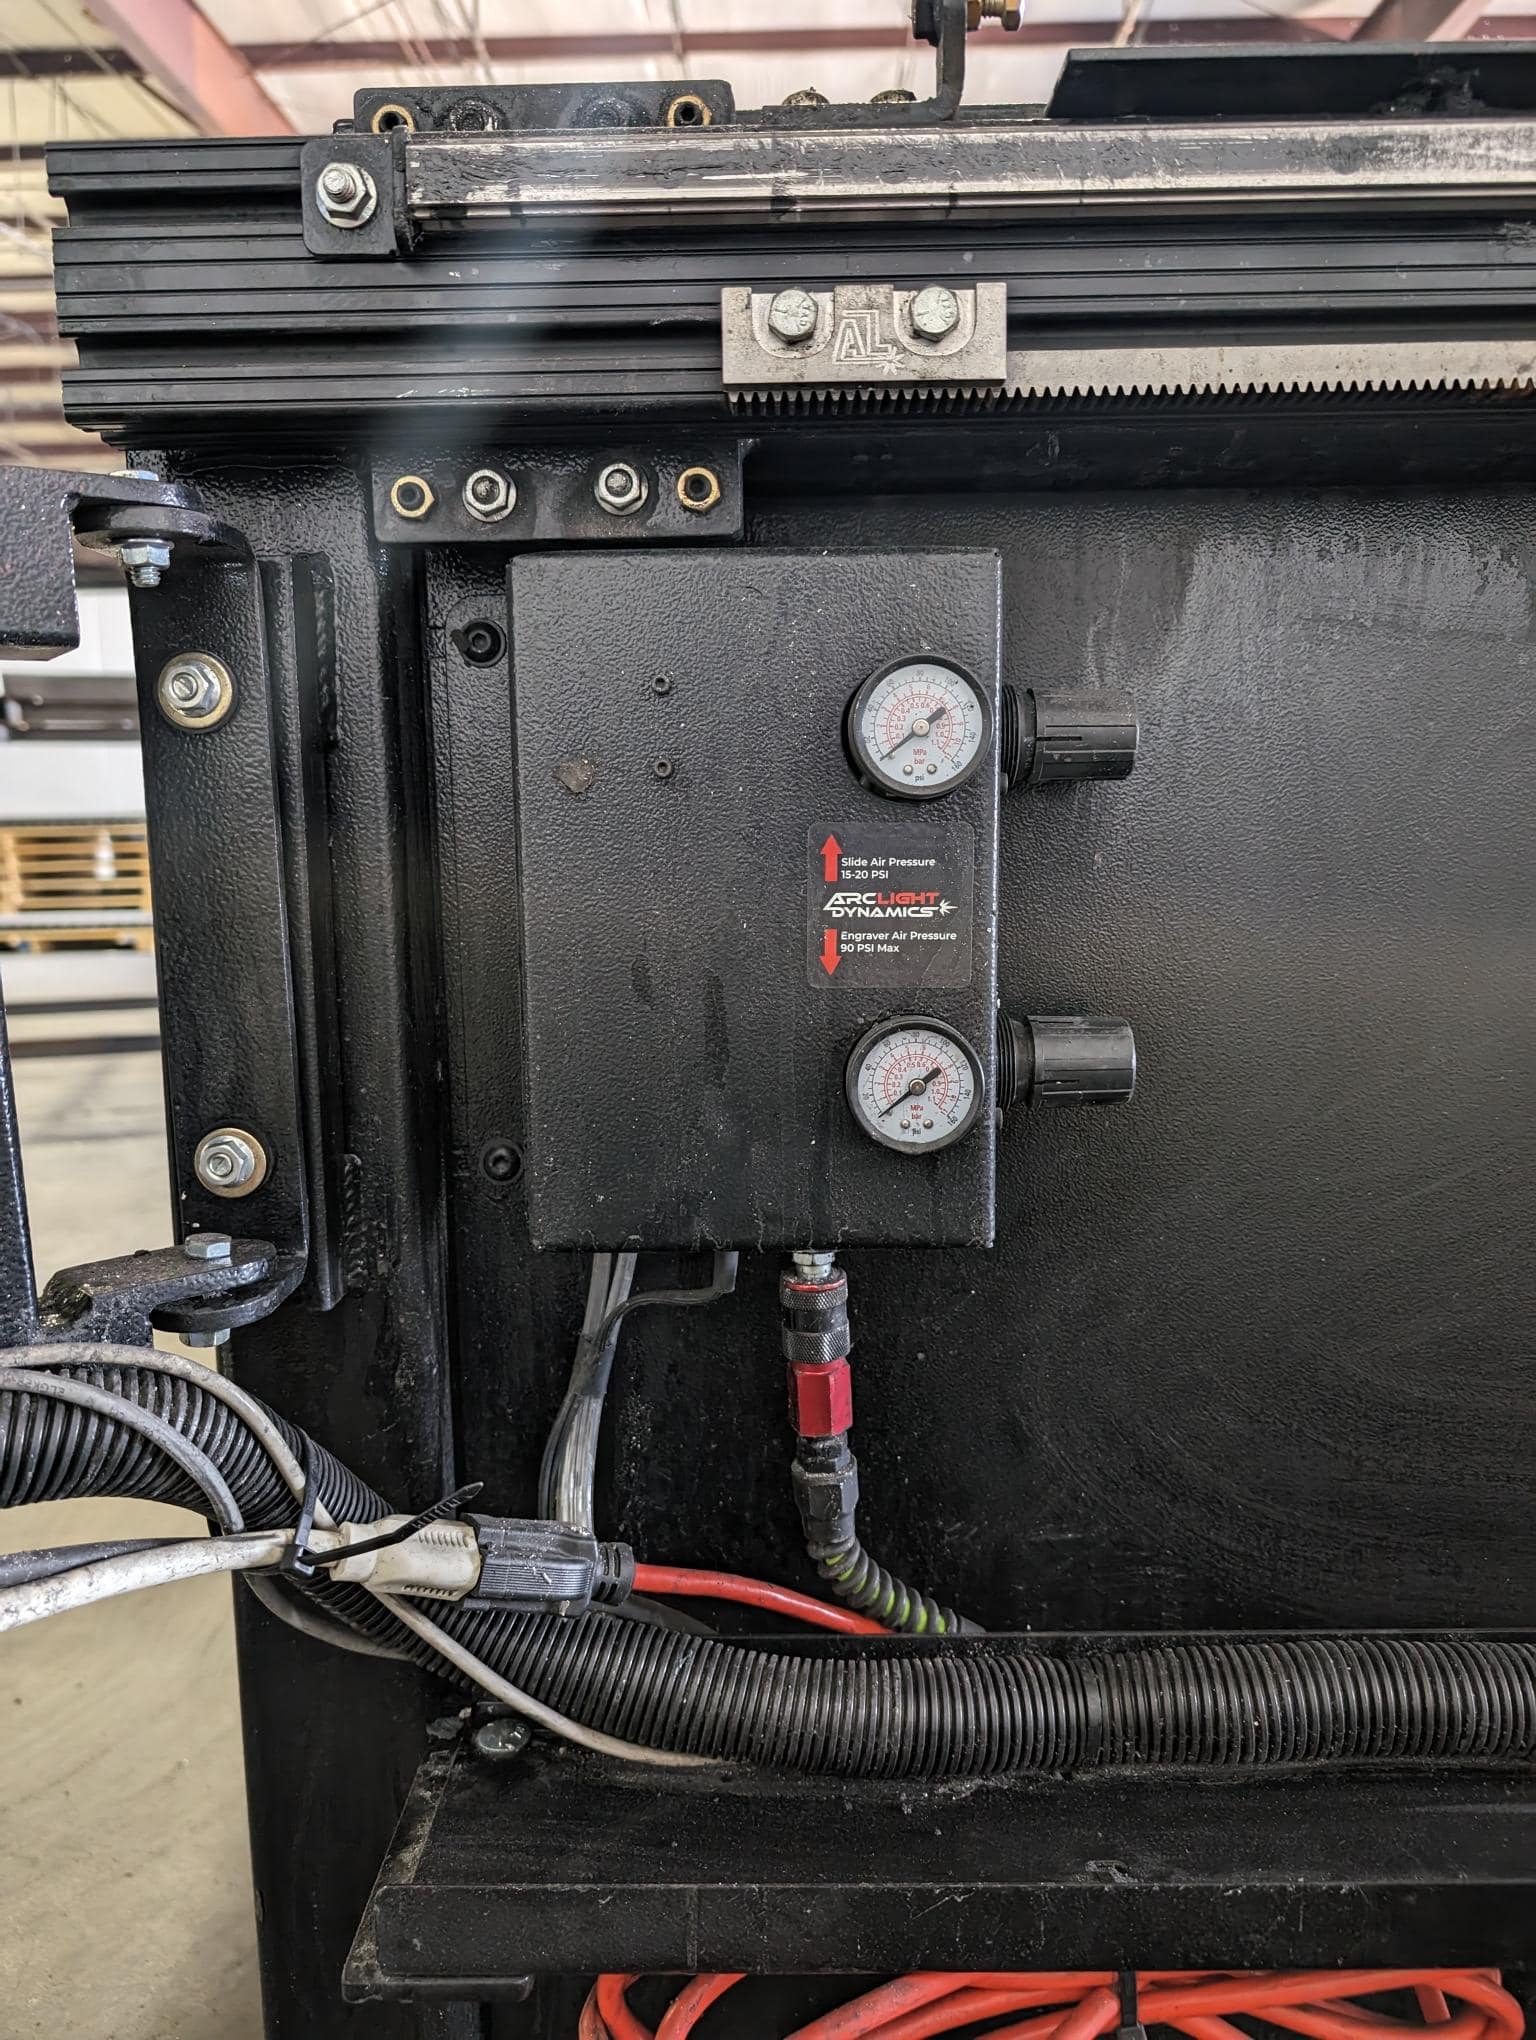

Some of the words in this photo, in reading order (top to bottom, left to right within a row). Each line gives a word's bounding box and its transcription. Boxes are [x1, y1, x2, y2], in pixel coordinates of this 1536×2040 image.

[841, 857, 868, 867] Slide
[870, 857, 886, 867] Air
[888, 857, 936, 867] Pressure
[841, 870, 869, 879] 15-20
[871, 870, 889, 880] PSI
[823, 892, 940, 910] ARCLIGHT
[831, 906, 940, 918] DYNAMICS
[840, 931, 890, 942] Engraver
[891, 931, 908, 940] Air
[910, 931, 958, 941] Pressure
[840, 943, 855, 953] 90
[857, 943, 875, 953] PSI
[877, 943, 900, 953] Max
